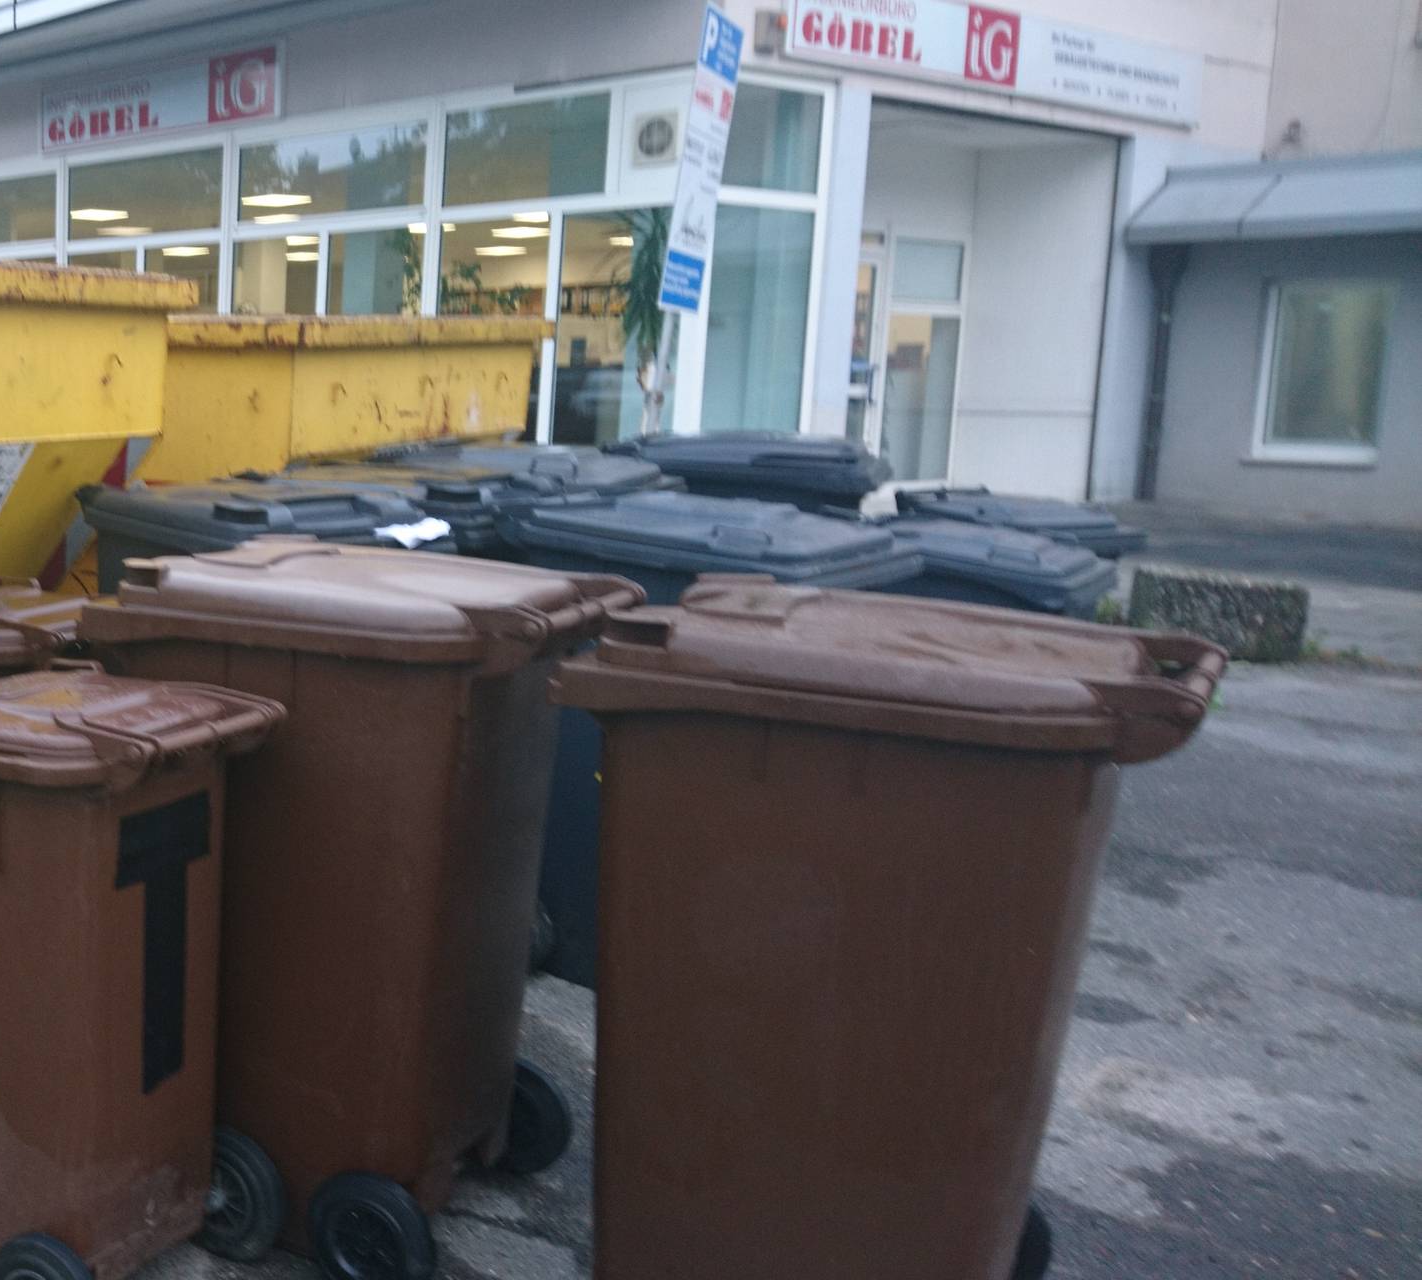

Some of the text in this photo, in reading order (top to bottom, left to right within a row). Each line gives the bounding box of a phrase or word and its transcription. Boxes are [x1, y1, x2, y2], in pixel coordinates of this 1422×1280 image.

[702, 10, 719, 61] P
[802, 10, 922, 62] GÖBEL
[48, 101, 159, 142] GÖBEL
[114, 789, 211, 1096] T
